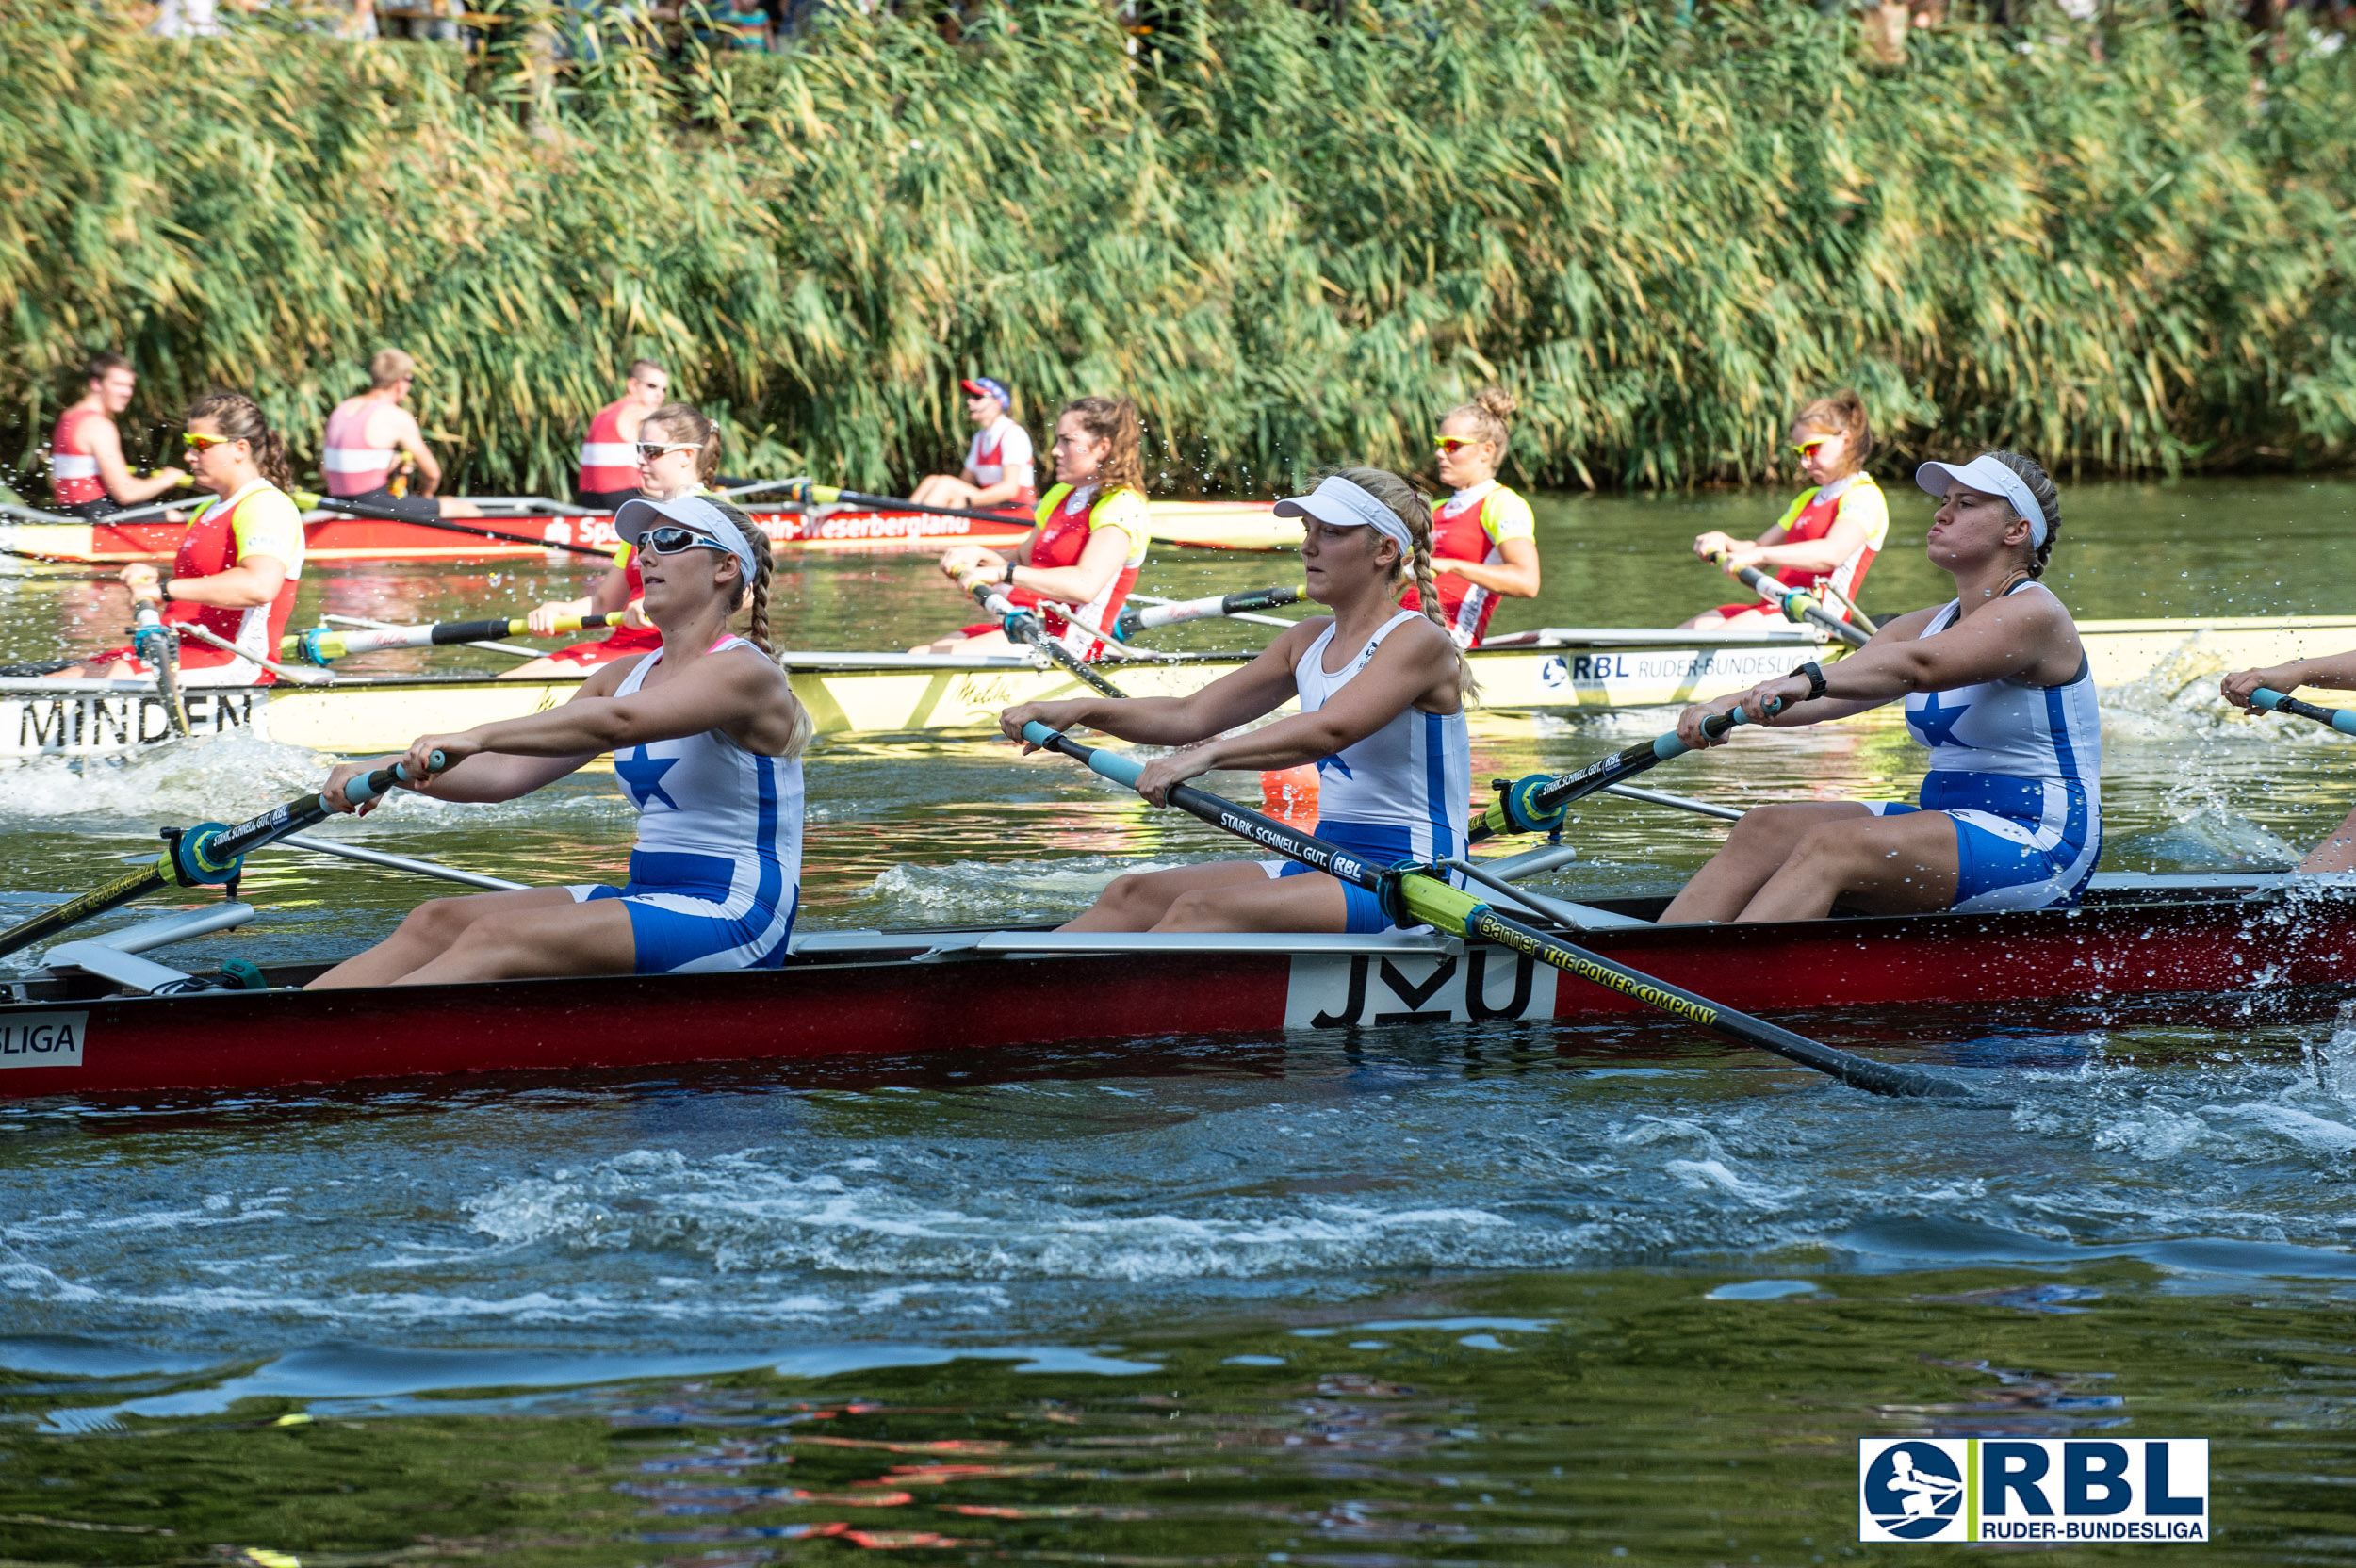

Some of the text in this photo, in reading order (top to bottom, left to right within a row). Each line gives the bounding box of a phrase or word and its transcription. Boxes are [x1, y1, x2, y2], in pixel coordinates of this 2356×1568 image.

[1573, 654, 1629, 679] RBL
[19, 695, 253, 747] MINDEN
[1220, 812, 1254, 839] STARK.
[1255, 826, 1302, 858] SCHNELL.
[1303, 847, 1328, 867] GUT.
[1333, 856, 1362, 879] RBL
[1479, 913, 1718, 1027] Banner THE POWER COMPANY
